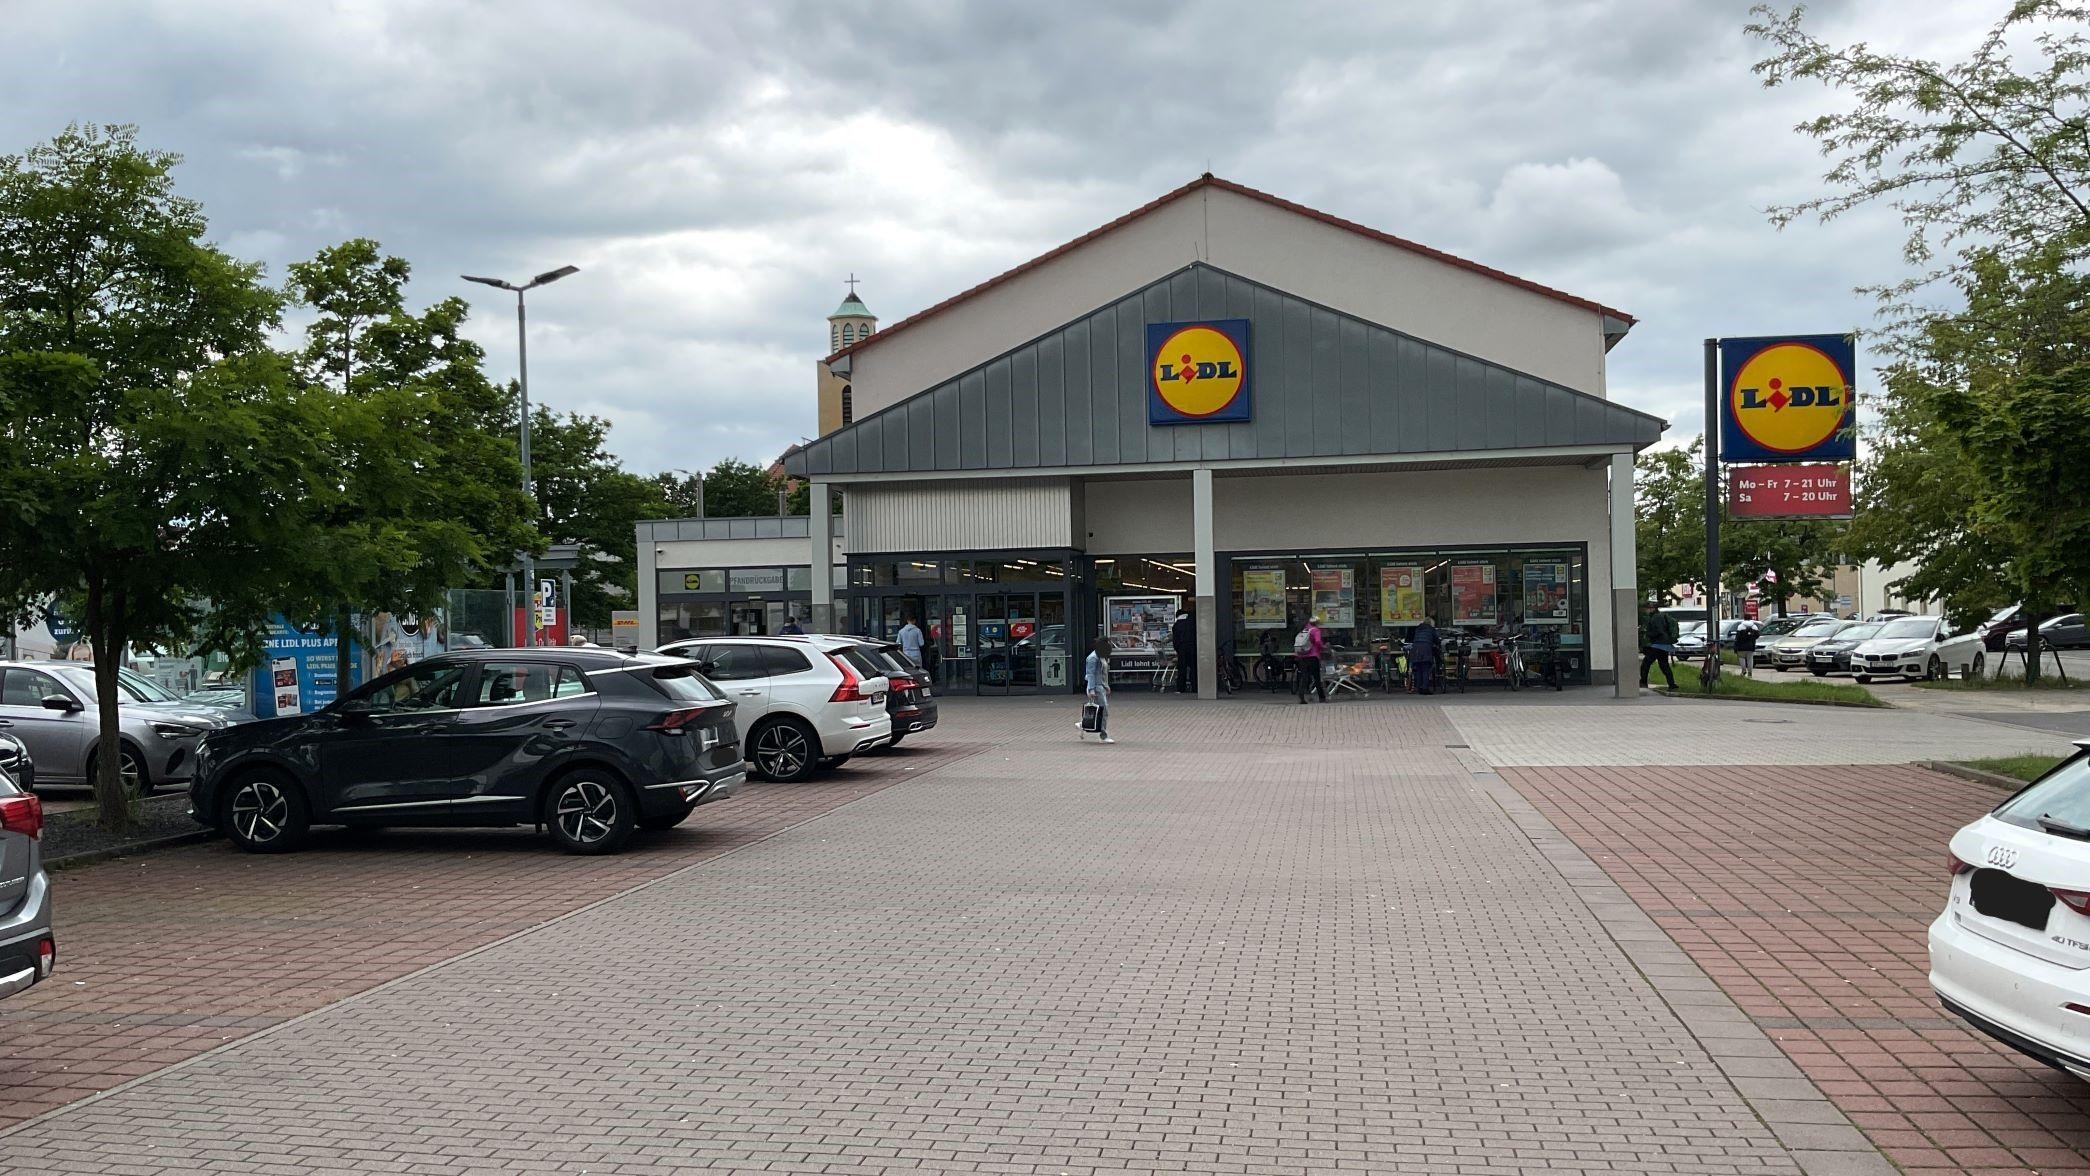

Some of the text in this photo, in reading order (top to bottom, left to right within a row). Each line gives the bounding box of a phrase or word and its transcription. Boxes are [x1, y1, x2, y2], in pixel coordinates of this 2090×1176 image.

[1739, 479, 1756, 489] Mo
[1767, 479, 1778, 489] Fr
[1784, 479, 1791, 488] 7
[1801, 479, 1813, 488] 21
[1817, 478, 1837, 488] Uhr
[1739, 493, 1752, 503] Sa
[1783, 493, 1790, 501] 7
[1801, 492, 1816, 501] 20
[1818, 491, 1838, 501] Uhr
[542, 581, 552, 606] P
[281, 639, 300, 648] LIDL
[301, 639, 322, 648] PLUS
